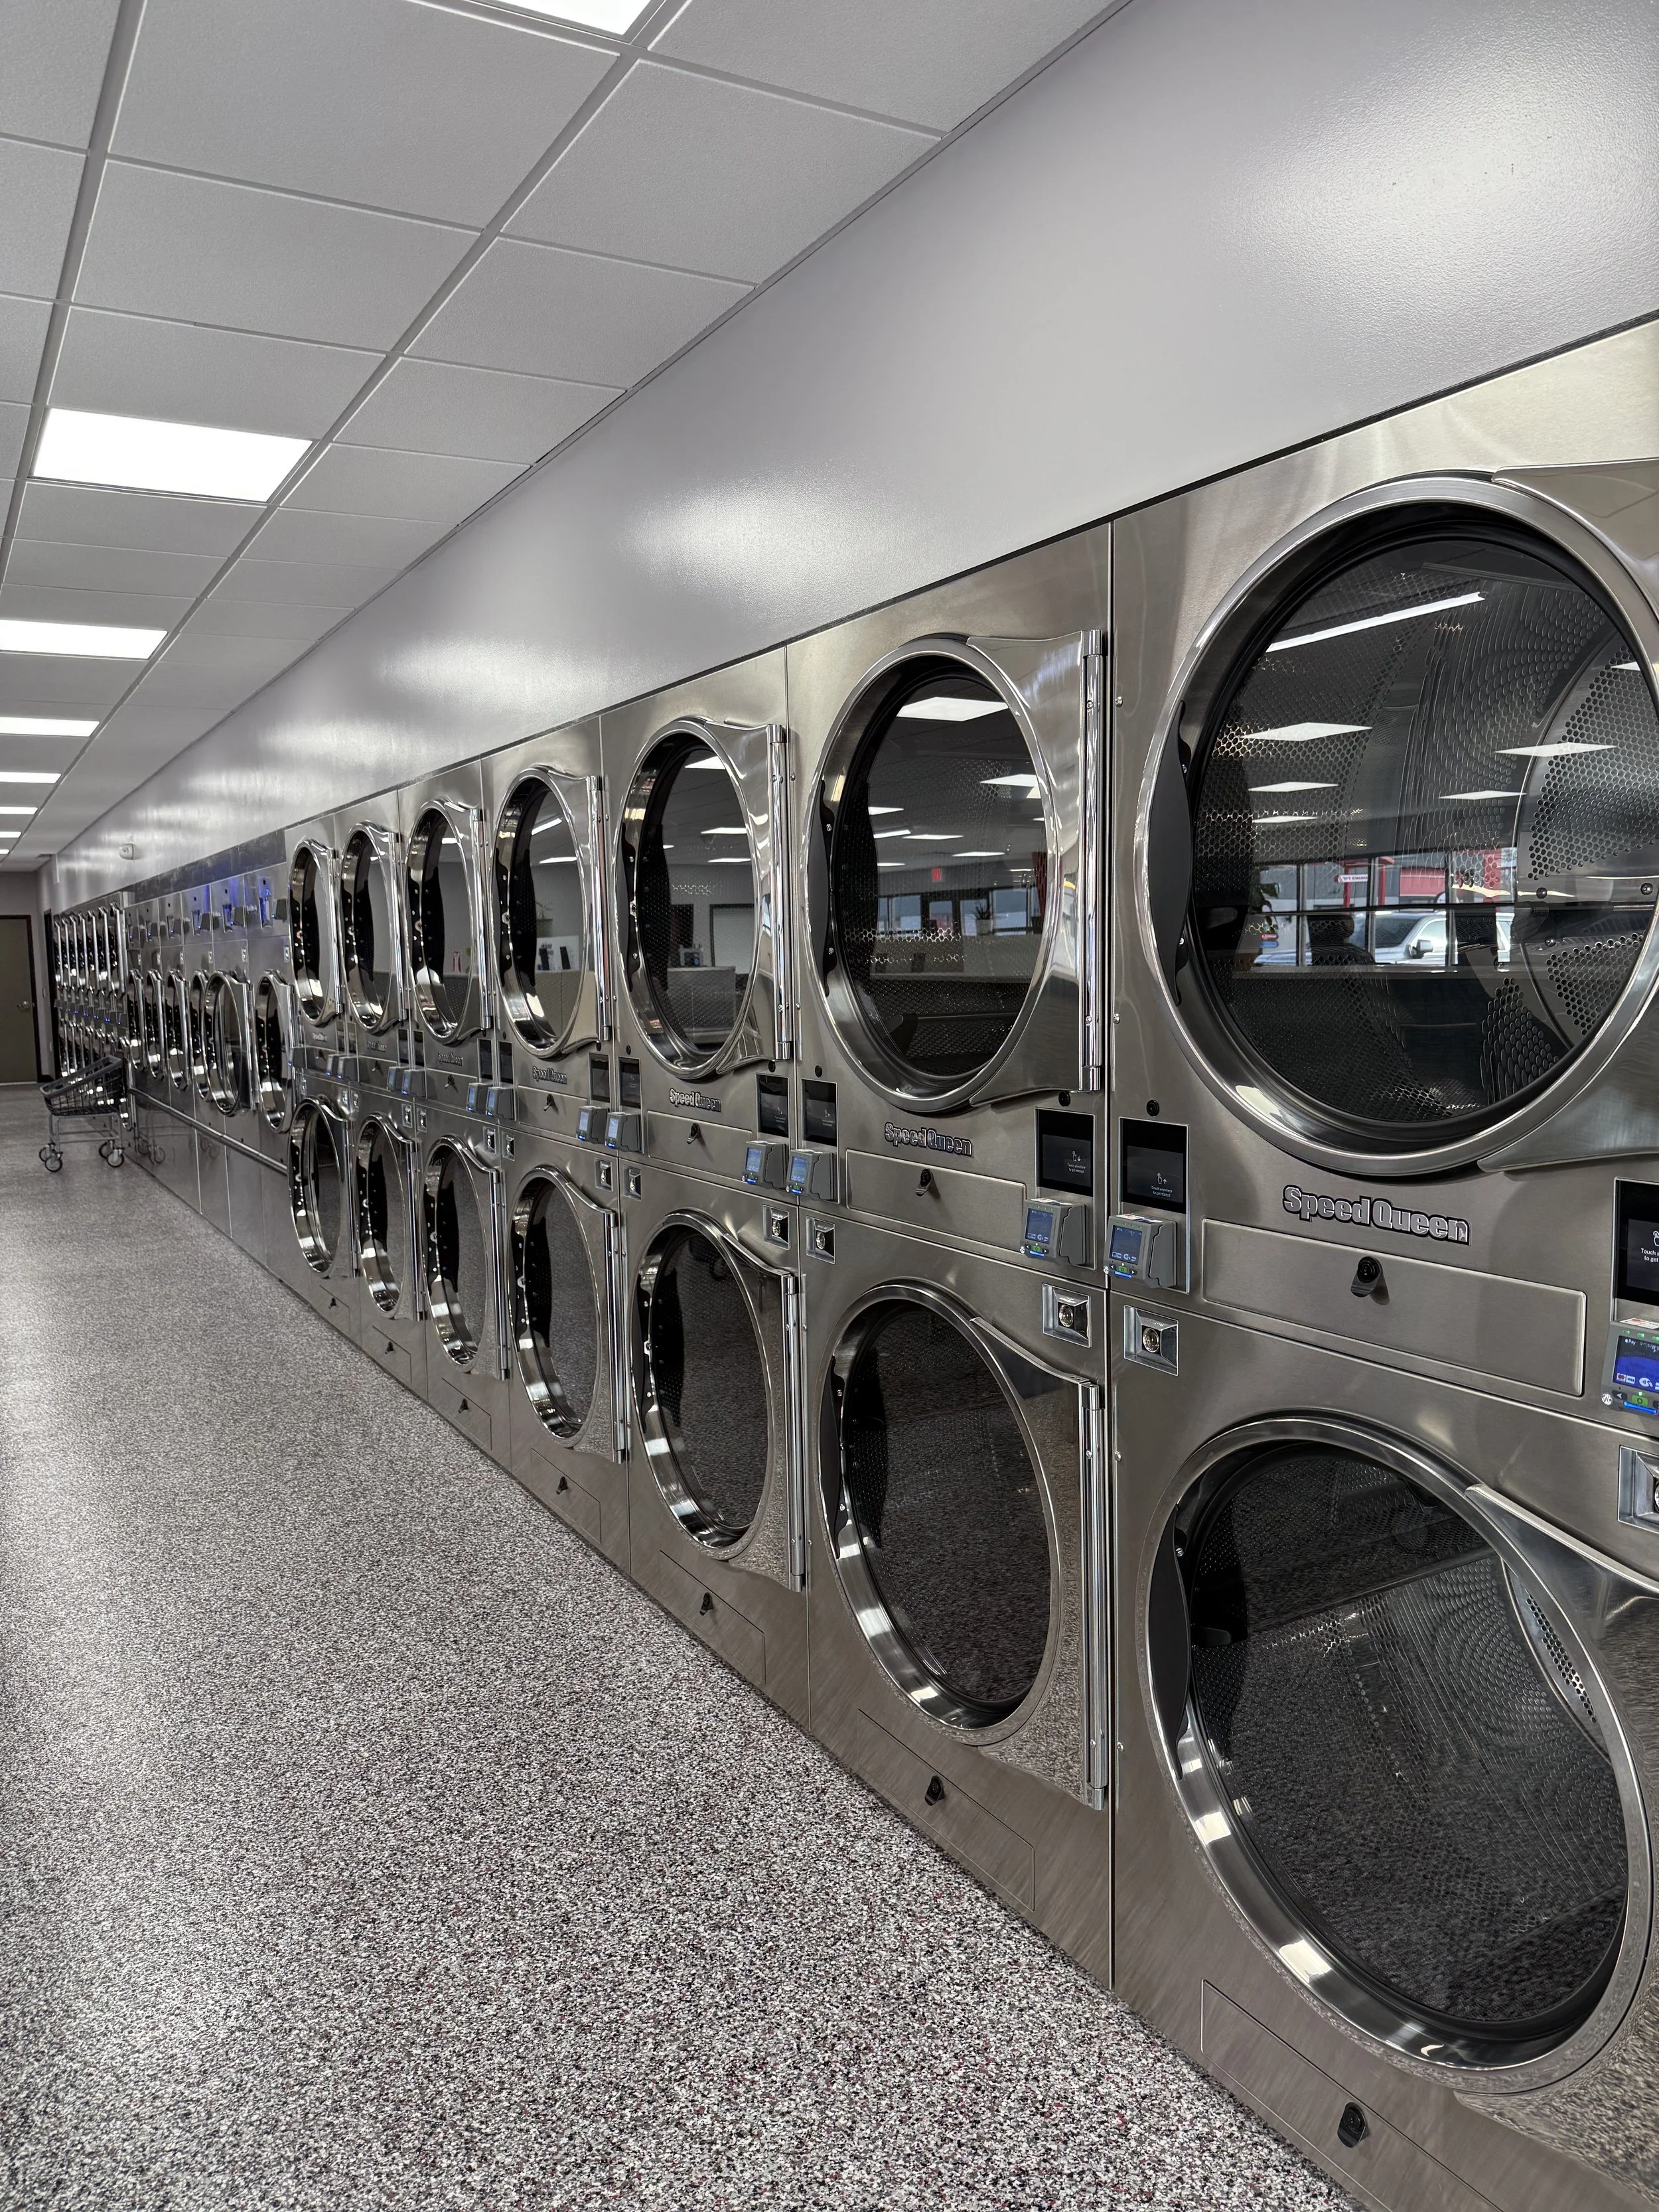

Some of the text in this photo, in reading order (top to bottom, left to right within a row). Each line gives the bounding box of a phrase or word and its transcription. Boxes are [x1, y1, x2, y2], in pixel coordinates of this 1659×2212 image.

[670, 1088, 695, 1107] Speed
[885, 1122, 972, 1157] Speed Queen
[1283, 1185, 1471, 1246] Speed Queen
